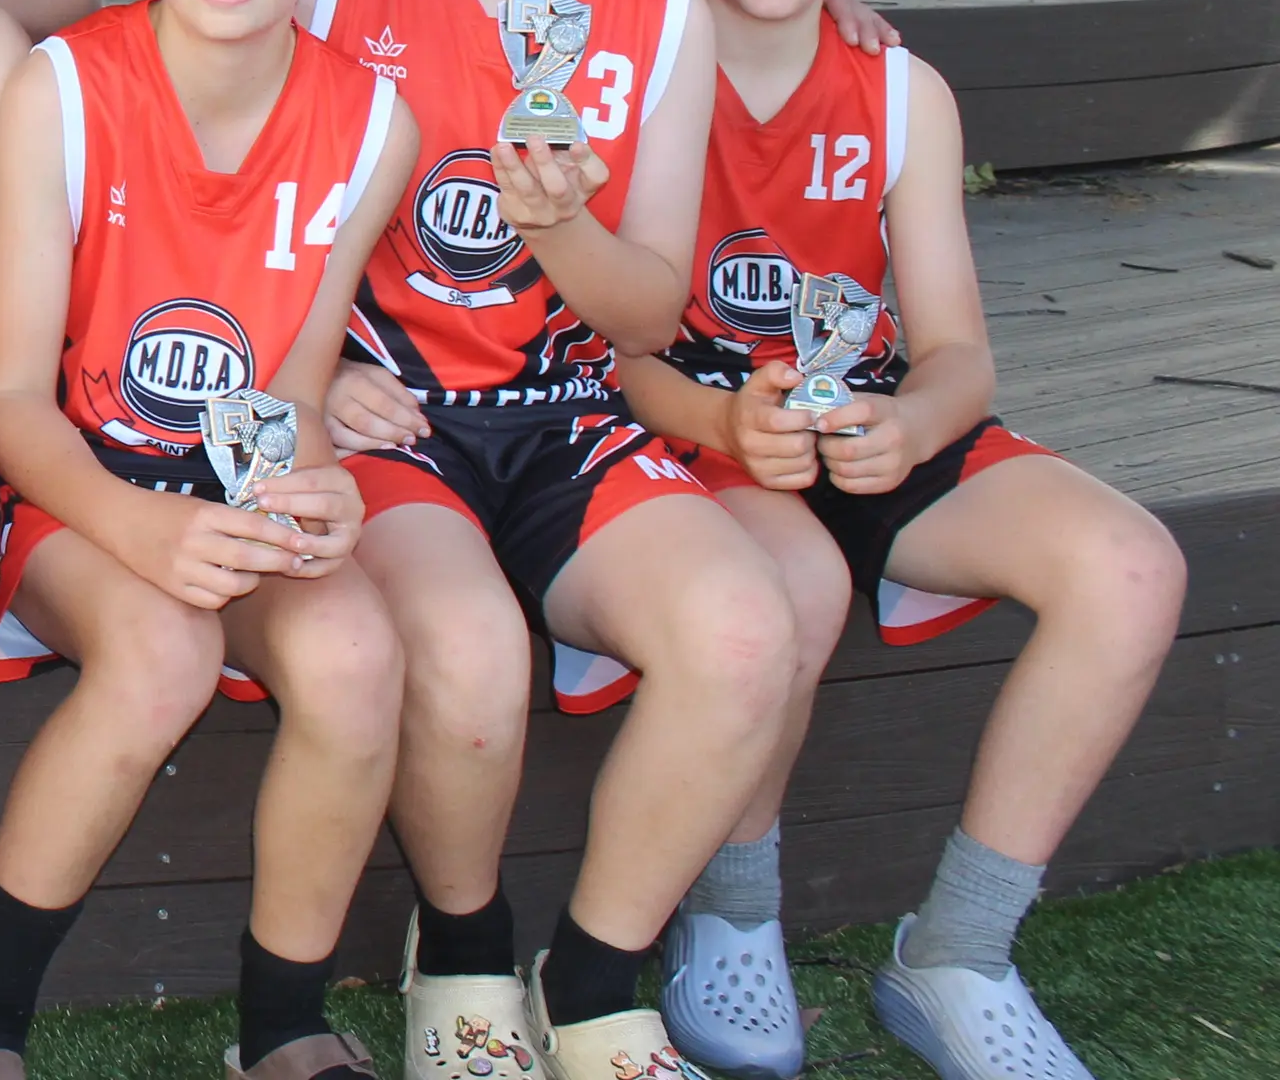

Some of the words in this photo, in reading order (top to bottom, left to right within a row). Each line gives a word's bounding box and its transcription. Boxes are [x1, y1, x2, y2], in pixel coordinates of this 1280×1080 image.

[803, 133, 871, 201] 12
[264, 181, 347, 271] 14
[722, 262, 790, 302] M.D.B.
[137, 340, 231, 392] M.D.B.A
